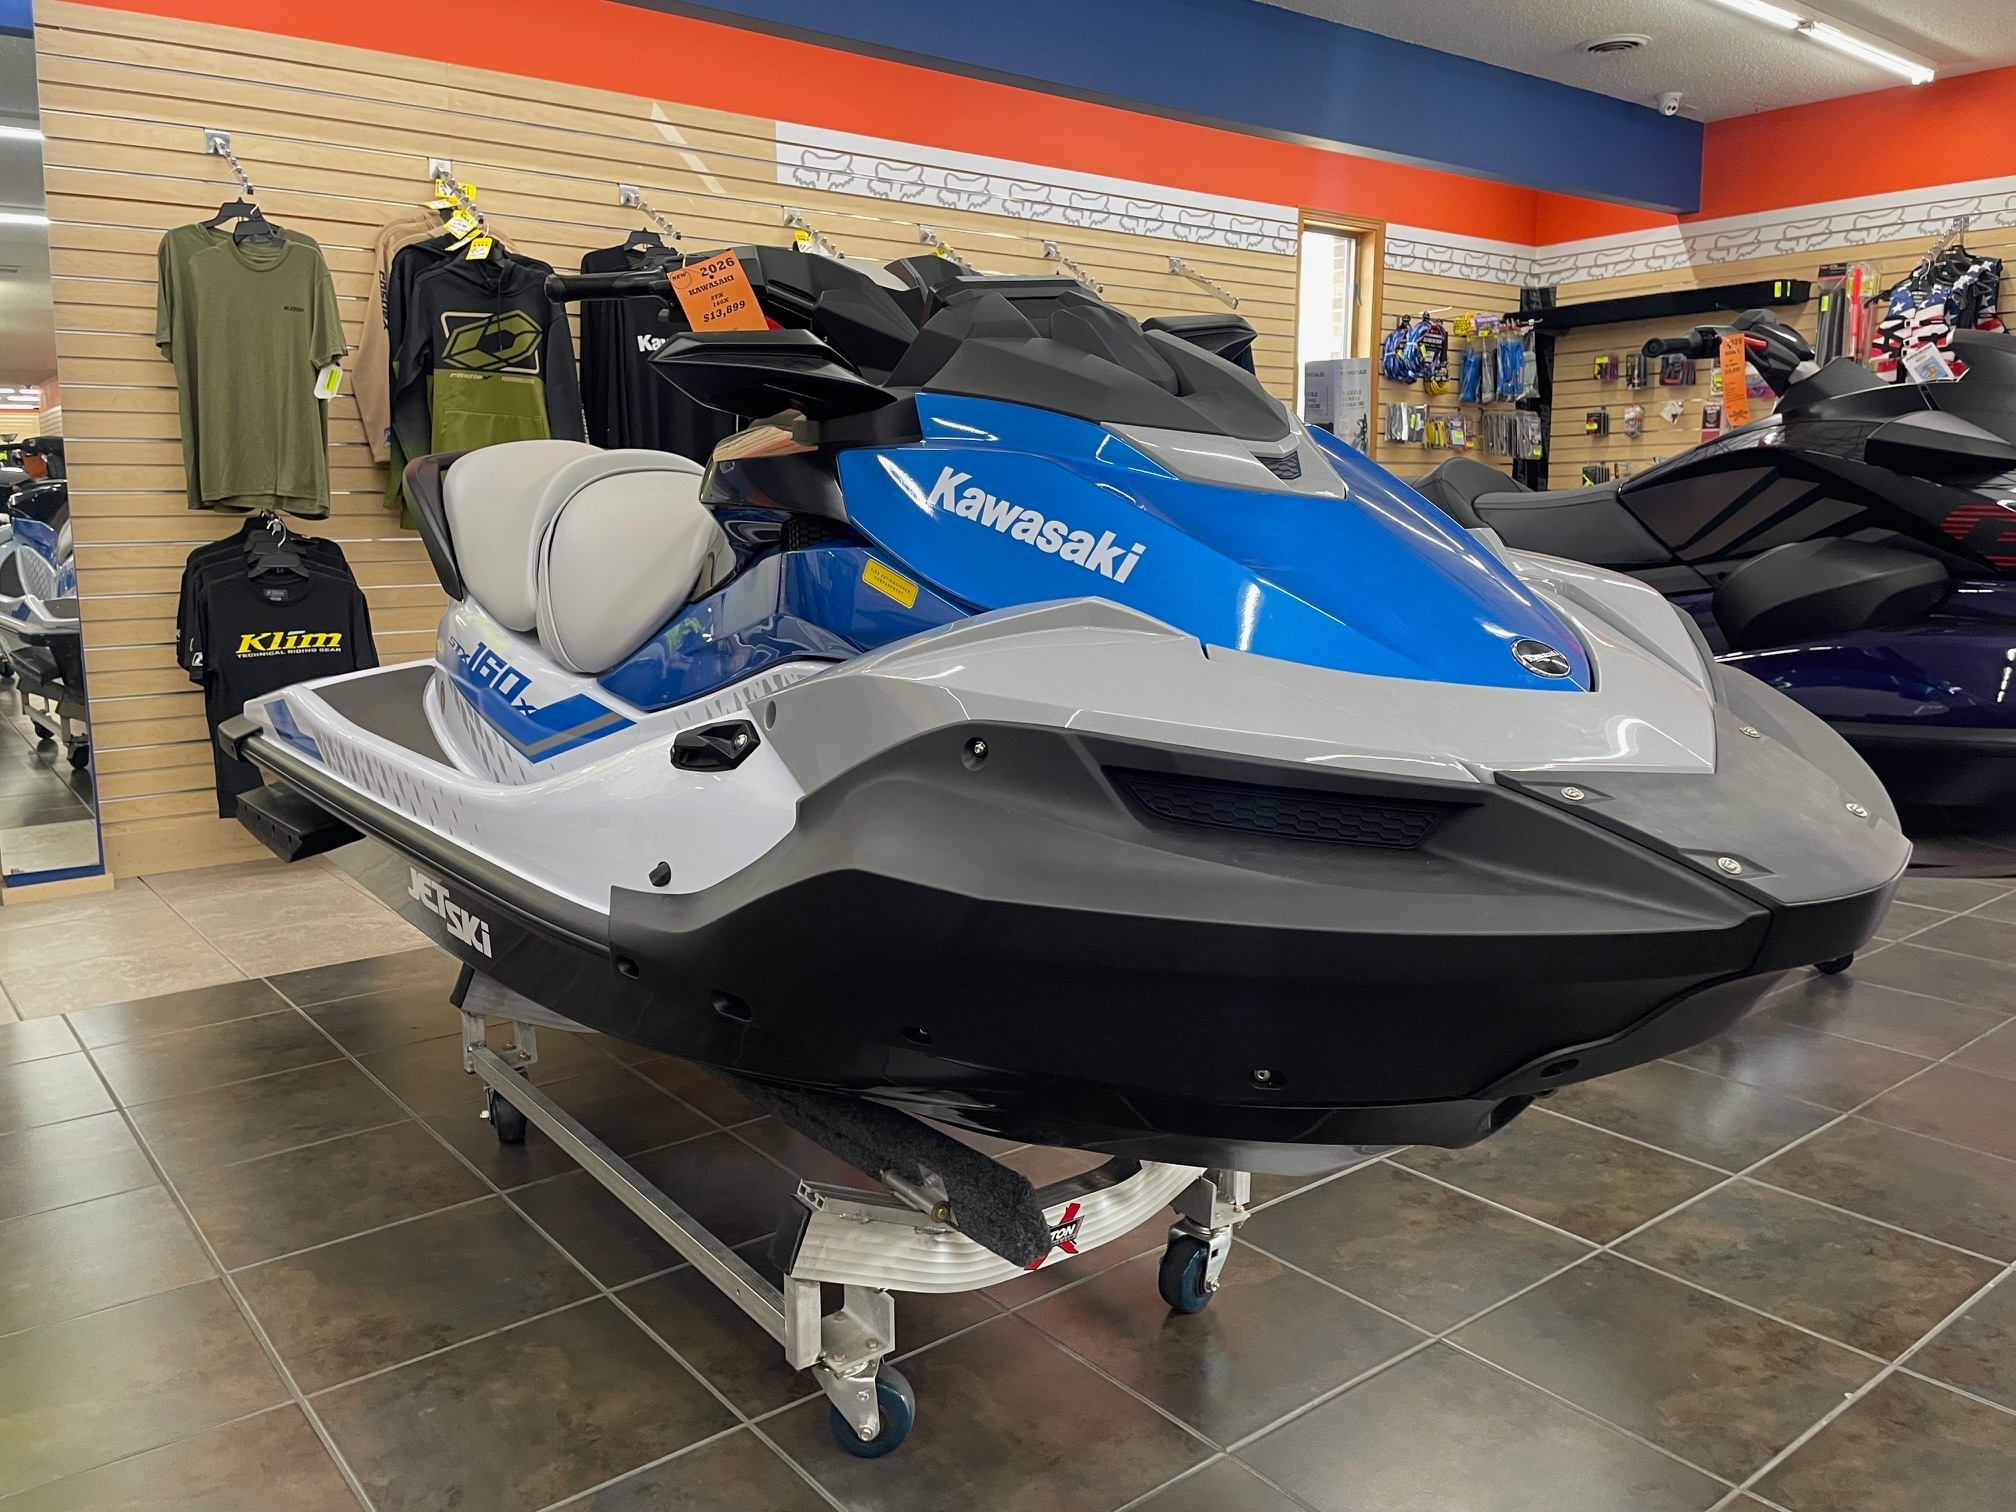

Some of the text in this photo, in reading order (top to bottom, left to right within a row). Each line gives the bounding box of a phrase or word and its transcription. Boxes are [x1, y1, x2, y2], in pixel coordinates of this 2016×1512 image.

[672, 271, 686, 280] NEW
[700, 257, 735, 277] 2026
[688, 275, 735, 296] KAWASAKI
[711, 292, 724, 301] STX
[713, 297, 730, 307] 160X
[703, 300, 746, 323] $13,899
[927, 466, 1147, 584] Kawasaki
[236, 630, 343, 654] Klim
[448, 636, 471, 665] STX
[236, 650, 287, 659] TECHNICAL
[407, 866, 450, 919] JET
